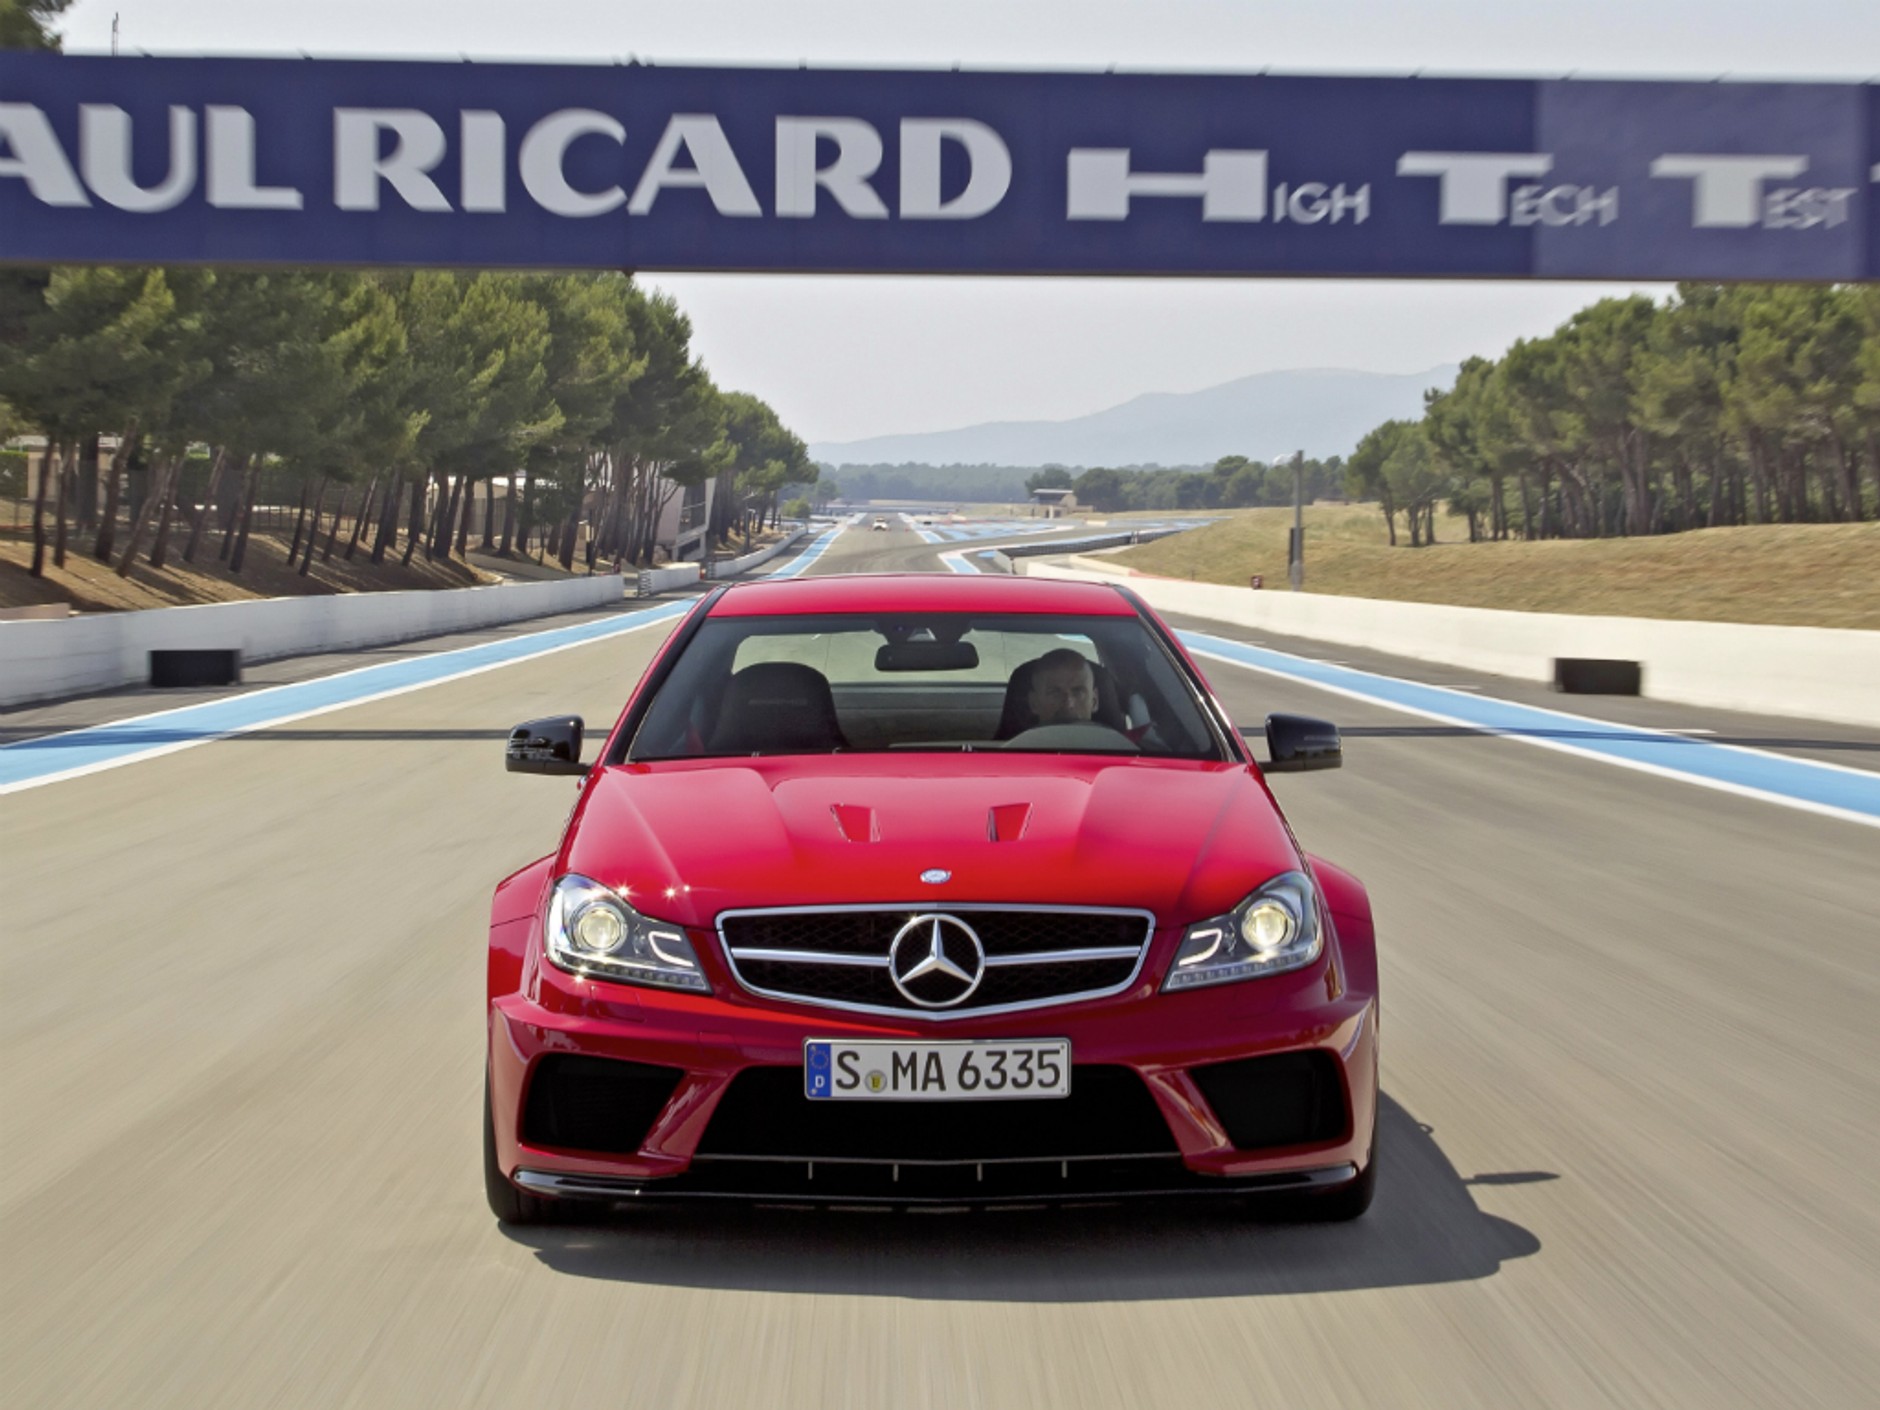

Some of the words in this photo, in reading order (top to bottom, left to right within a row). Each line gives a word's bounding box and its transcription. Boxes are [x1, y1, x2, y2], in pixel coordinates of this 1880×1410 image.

[333, 106, 1012, 219] RICARD
[814, 1075, 825, 1088] D
[835, 1050, 861, 1090] S
[891, 1051, 946, 1091] MA
[957, 1049, 1061, 1090] 6335
